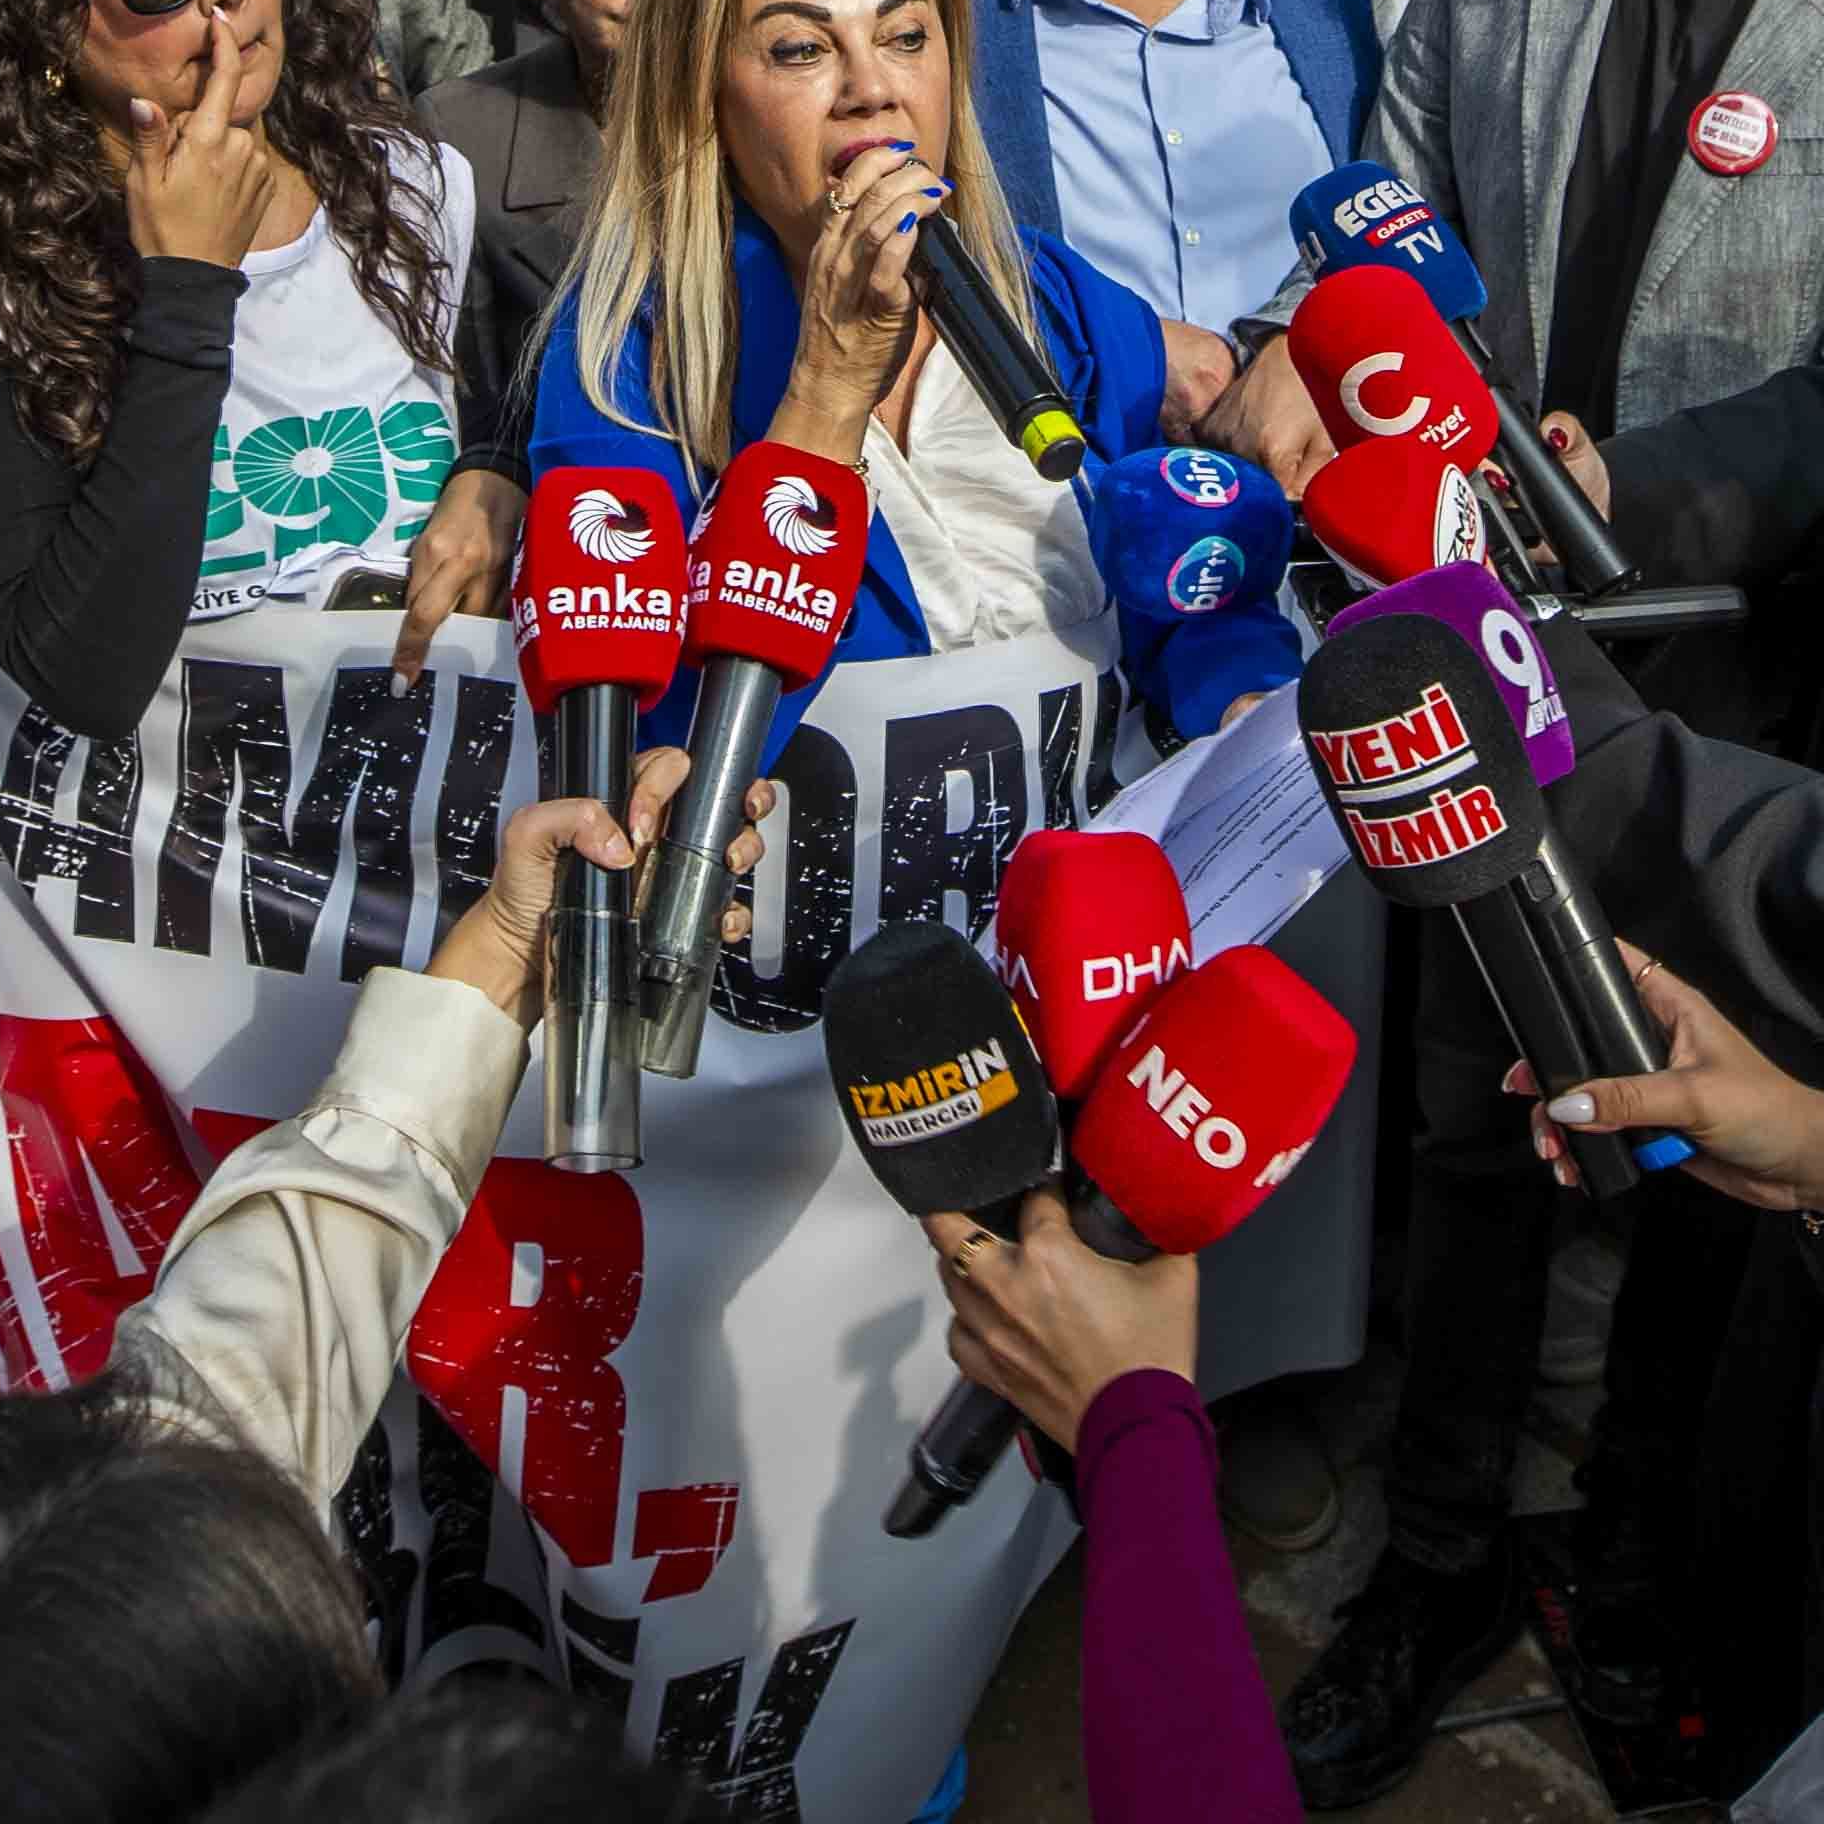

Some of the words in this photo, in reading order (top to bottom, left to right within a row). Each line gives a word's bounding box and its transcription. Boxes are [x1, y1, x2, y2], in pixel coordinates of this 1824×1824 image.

[1376, 209, 1429, 240] GAZETE
[1394, 225, 1445, 265] TV
[548, 573, 673, 615] anka
[724, 560, 838, 619] anka
[612, 615, 671, 633] AJANSI
[1481, 608, 1545, 704] 9
[1310, 681, 1474, 783] YENİ
[1345, 780, 1508, 869] İZMİR
[1082, 937, 1192, 1002] DHA
[1127, 1044, 1248, 1170] NEO
